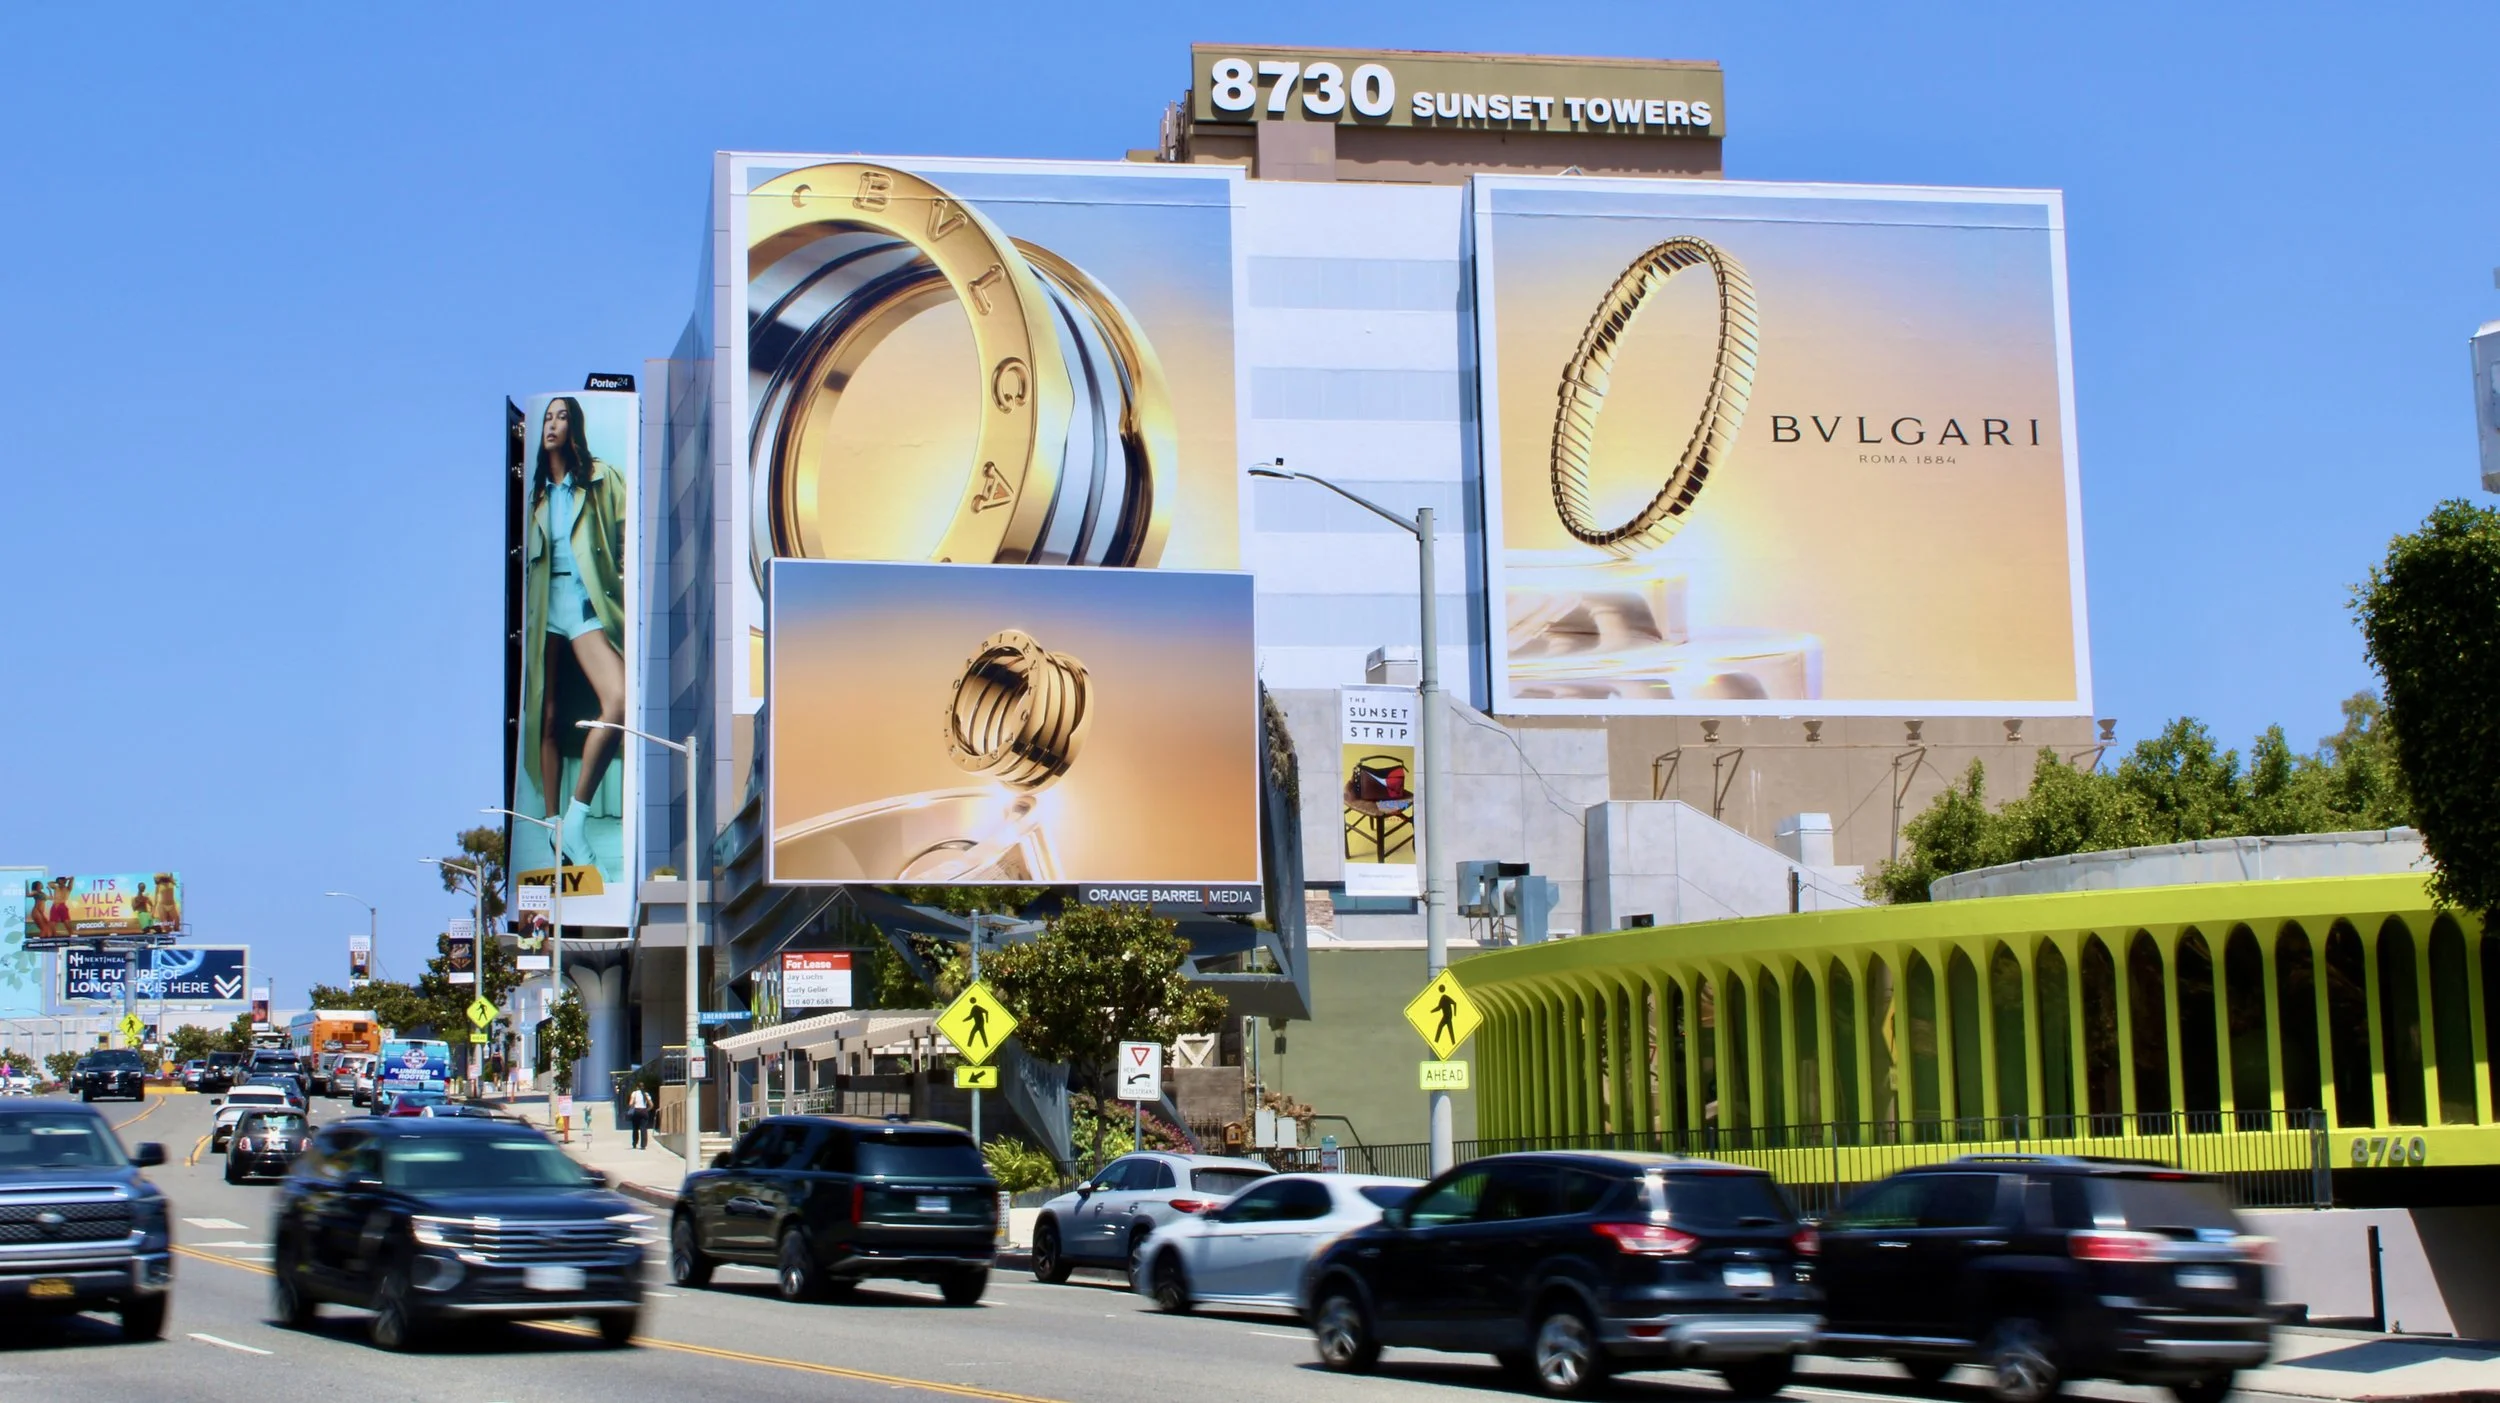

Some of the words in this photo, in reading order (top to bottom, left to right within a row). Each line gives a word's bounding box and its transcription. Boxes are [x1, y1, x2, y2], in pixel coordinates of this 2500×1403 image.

[1211, 57, 1396, 117] 8730
[1412, 91, 1554, 121] SUNSET
[1564, 96, 1713, 127] TOWERS
[852, 170, 1030, 562] BVLGA
[1770, 414, 2041, 447] BVLGARI
[1858, 453, 1908, 465] ROMA
[1915, 454, 1957, 466] 1884
[1348, 696, 1367, 704] THE
[1349, 706, 1409, 720] SUNSET
[1350, 726, 1408, 740] STRIP
[92, 878, 116, 891] IT'S
[81, 892, 123, 905] VILLA
[1088, 889, 1149, 902] ORANGE
[1151, 890, 1203, 903] BARREL
[1209, 890, 1253, 904] MEDIA
[84, 905, 120, 918] TIME
[76, 920, 106, 931] peacock
[785, 959, 802, 970] For
[803, 959, 832, 970] Lease
[70, 968, 99, 980] THE
[102, 968, 159, 980] FURE
[163, 967, 181, 980] OF
[787, 973, 800, 982] Jay
[155, 981, 168, 993] IS
[171, 982, 209, 993] HERE
[787, 986, 806, 994] Carly
[389, 1067, 432, 1076] PLUMBING
[1426, 1069, 1464, 1081] AHEAD
[2352, 1136, 2426, 1163] 8760
